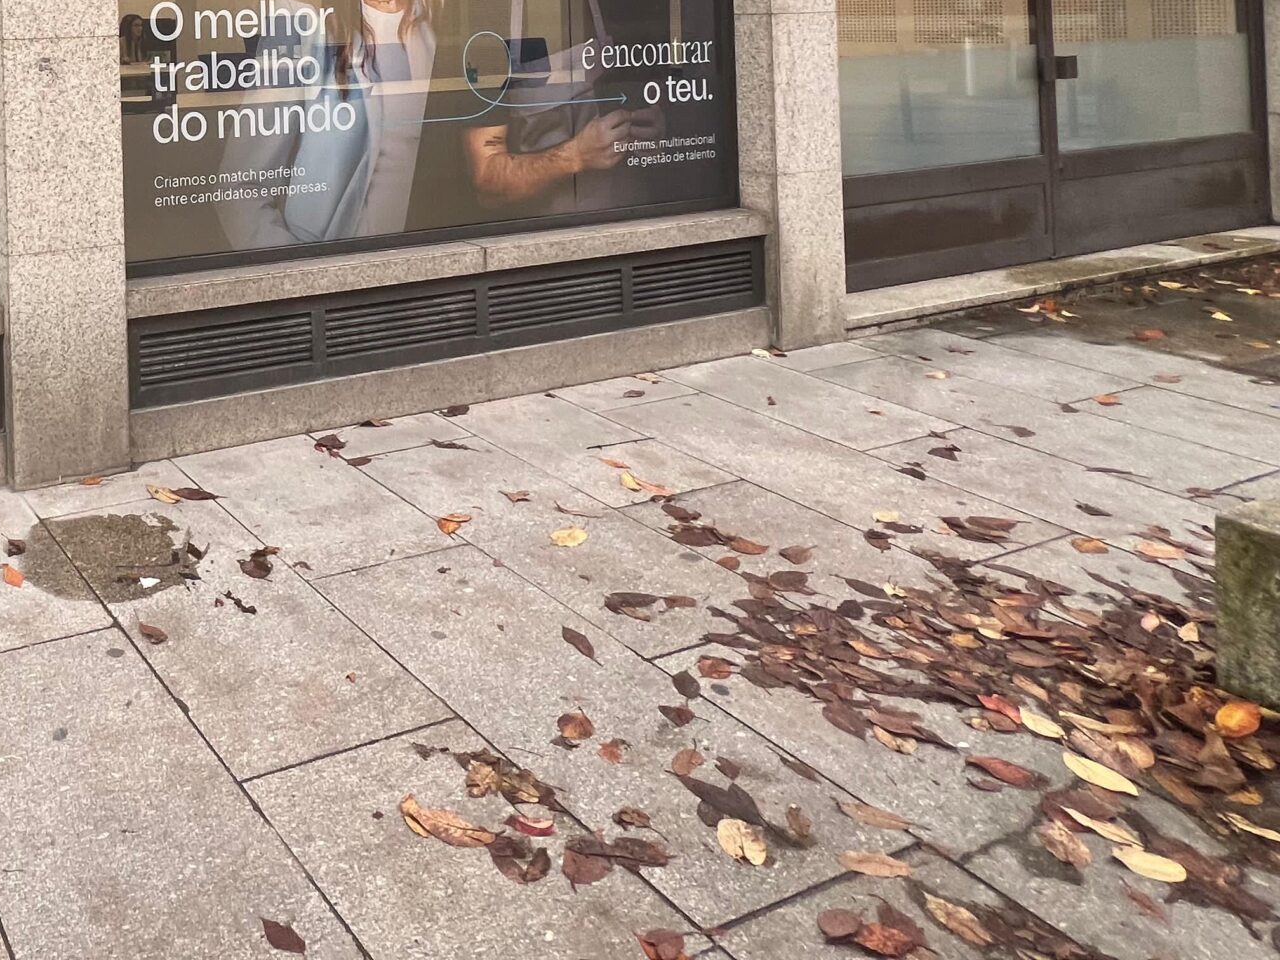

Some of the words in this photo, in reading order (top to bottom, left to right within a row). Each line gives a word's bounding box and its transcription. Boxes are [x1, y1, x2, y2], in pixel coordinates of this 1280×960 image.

[150, 2, 183, 41] O
[194, 0, 334, 39] melhor
[582, 38, 595, 69] é
[601, 37, 712, 68] encontrar
[150, 49, 320, 92] trabalho
[644, 81, 660, 104] o
[666, 76, 713, 102] teu.
[153, 104, 207, 144] do
[218, 95, 356, 138] mundo
[659, 134, 715, 147] multinacional
[627, 156, 639, 166] de
[641, 153, 671, 167] gestão
[673, 152, 684, 161] de
[686, 149, 716, 160] talento
[154, 176, 206, 189] Criamos
[208, 174, 217, 184] o
[220, 168, 257, 183] match
[259, 165, 306, 180] perfeito
[155, 194, 187, 207] entre
[190, 188, 259, 204] candidatos
[261, 187, 268, 196] e
[270, 181, 330, 198] empresas.
